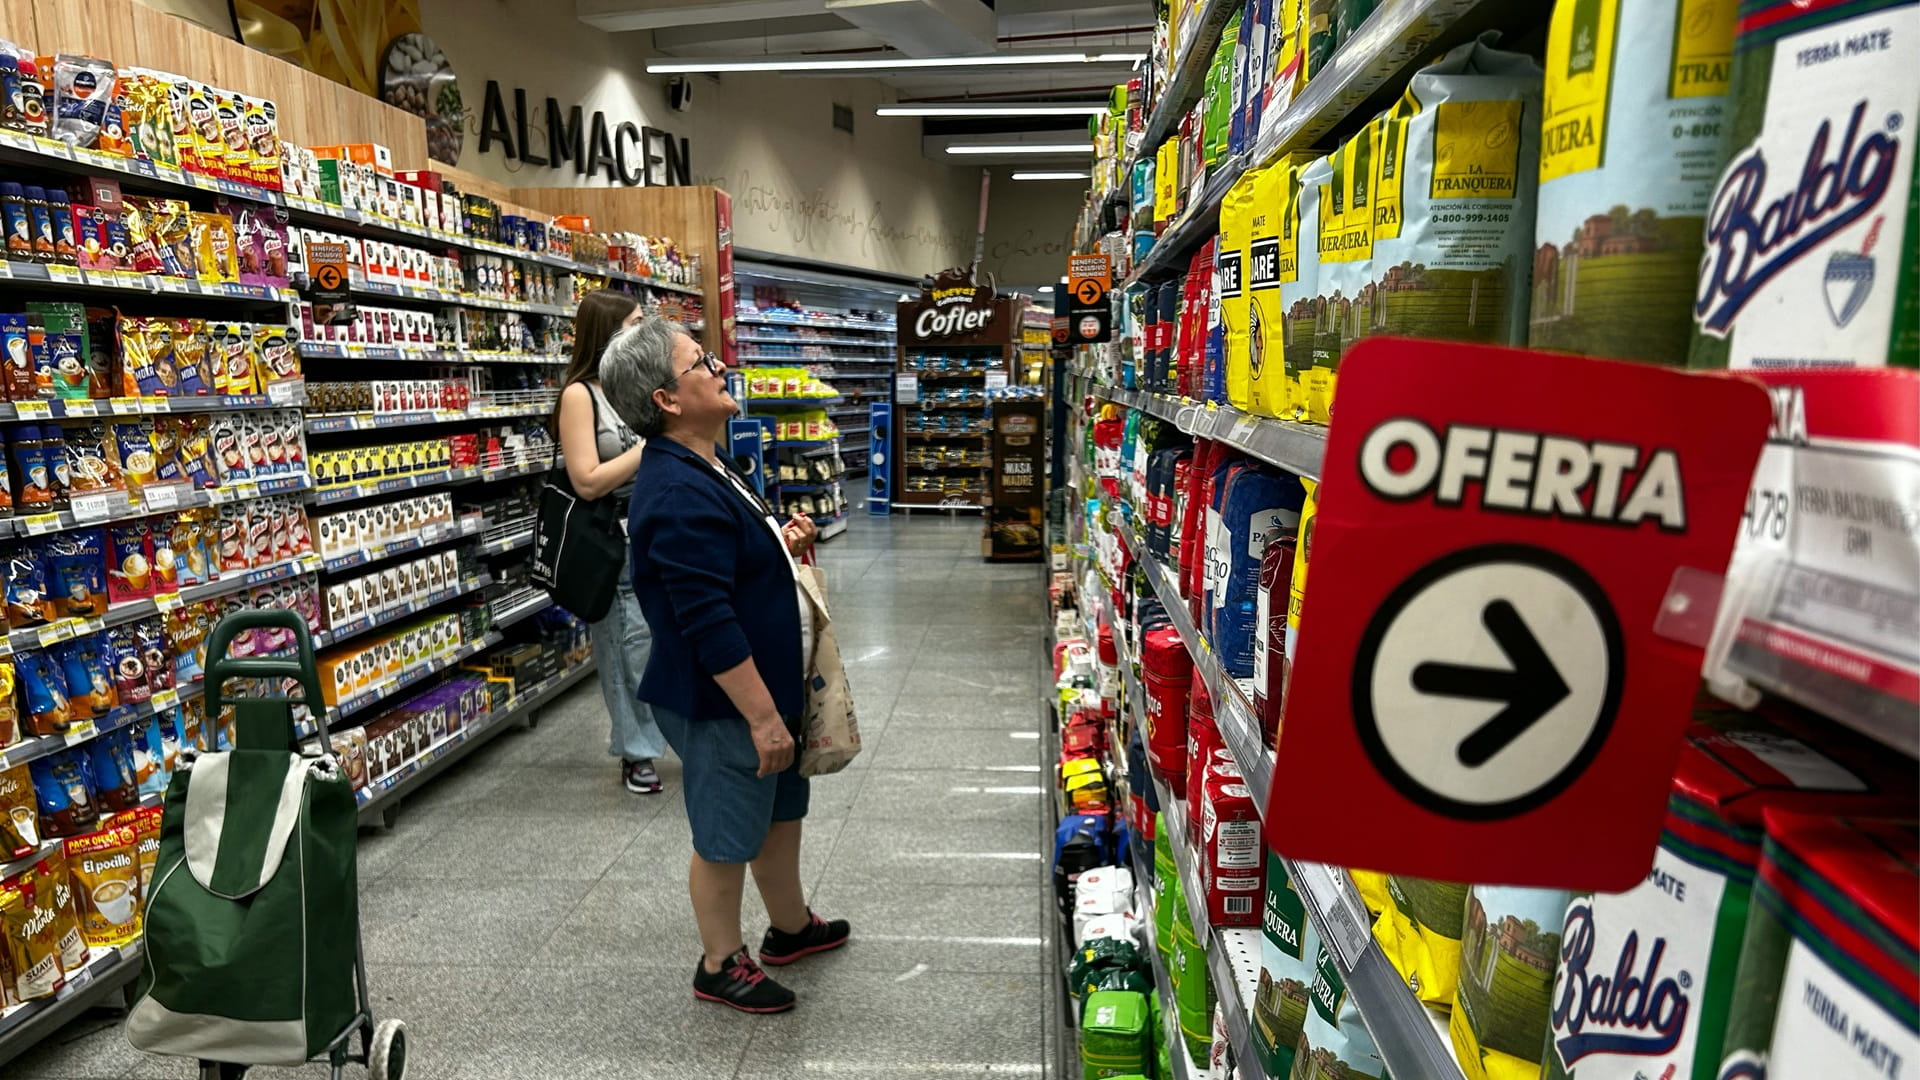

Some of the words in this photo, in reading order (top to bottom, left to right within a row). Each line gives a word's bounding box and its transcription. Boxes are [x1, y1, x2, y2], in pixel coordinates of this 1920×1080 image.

[1847, 28, 1892, 59] MATE
[478, 80, 691, 187] ALMACEN
[1469, 164, 1484, 175] LA
[1435, 177, 1513, 193] TRANQUERA
[1429, 203, 1462, 212] ATENCIÓN
[1463, 203, 1470, 211] AL
[1472, 203, 1513, 211] CONSUMIDOR
[1432, 213, 1510, 224] 0-800-999-1405
[1696, 99, 1899, 320] Baldo
[932, 287, 977, 301] Nuevas
[915, 305, 992, 338] Cofler
[1767, 384, 1807, 441] TA
[1004, 462, 1032, 474] MASA
[1359, 417, 1688, 531] OFERTA
[1002, 475, 1034, 486] MADRE
[68, 838, 91, 850] PACK
[83, 860, 94, 874] El
[95, 854, 131, 875] pocillo
[1268, 889, 1278, 909] LA
[22, 907, 56, 941] Planta
[25, 954, 54, 982] SUAVE
[1318, 946, 1330, 969] LA
[1552, 904, 1690, 1037] Baldo
[1804, 980, 1848, 1034] YERBA
[1853, 1023, 1904, 1078] MATE
